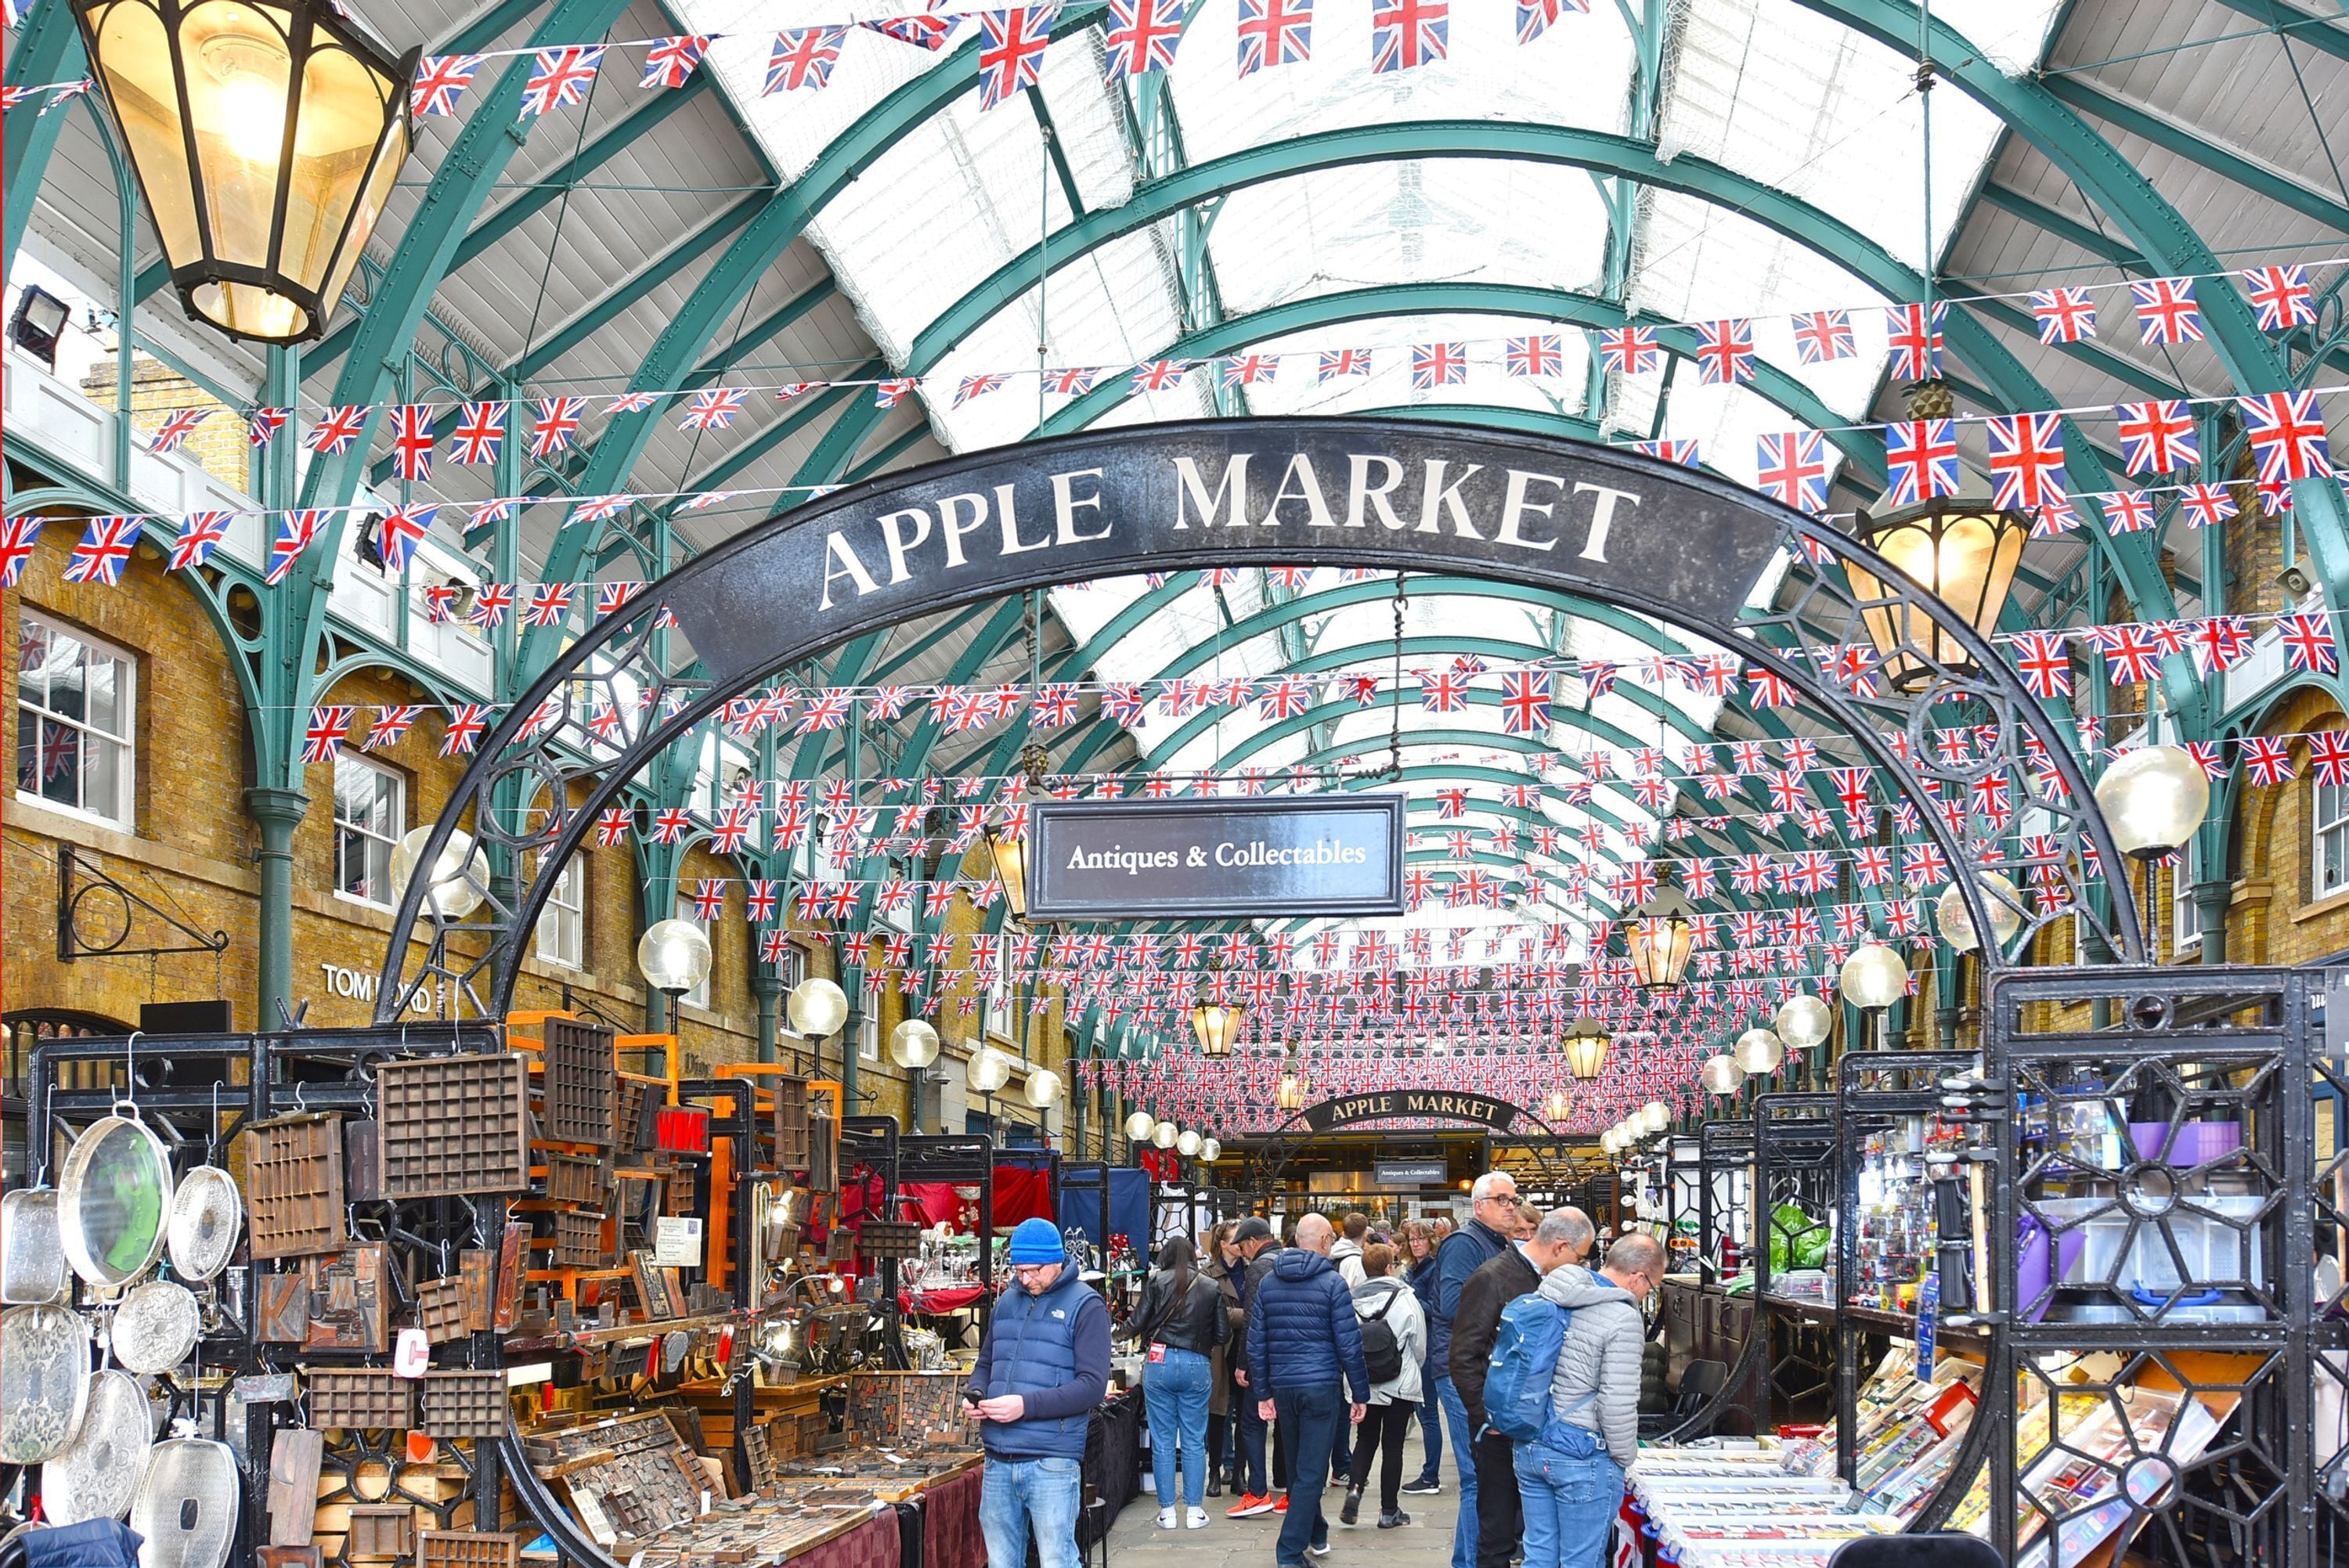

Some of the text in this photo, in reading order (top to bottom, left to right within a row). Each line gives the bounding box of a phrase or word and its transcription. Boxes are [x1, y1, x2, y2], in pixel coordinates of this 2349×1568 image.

[818, 453, 1640, 611] APPLE MARKET
[1066, 839, 1366, 875] Antiques & Collectables
[322, 963, 371, 1002] TOM
[1332, 1095, 1498, 1121] APPLE MARKET
[256, 1274, 305, 1341] K
[394, 1328, 429, 1378] C
